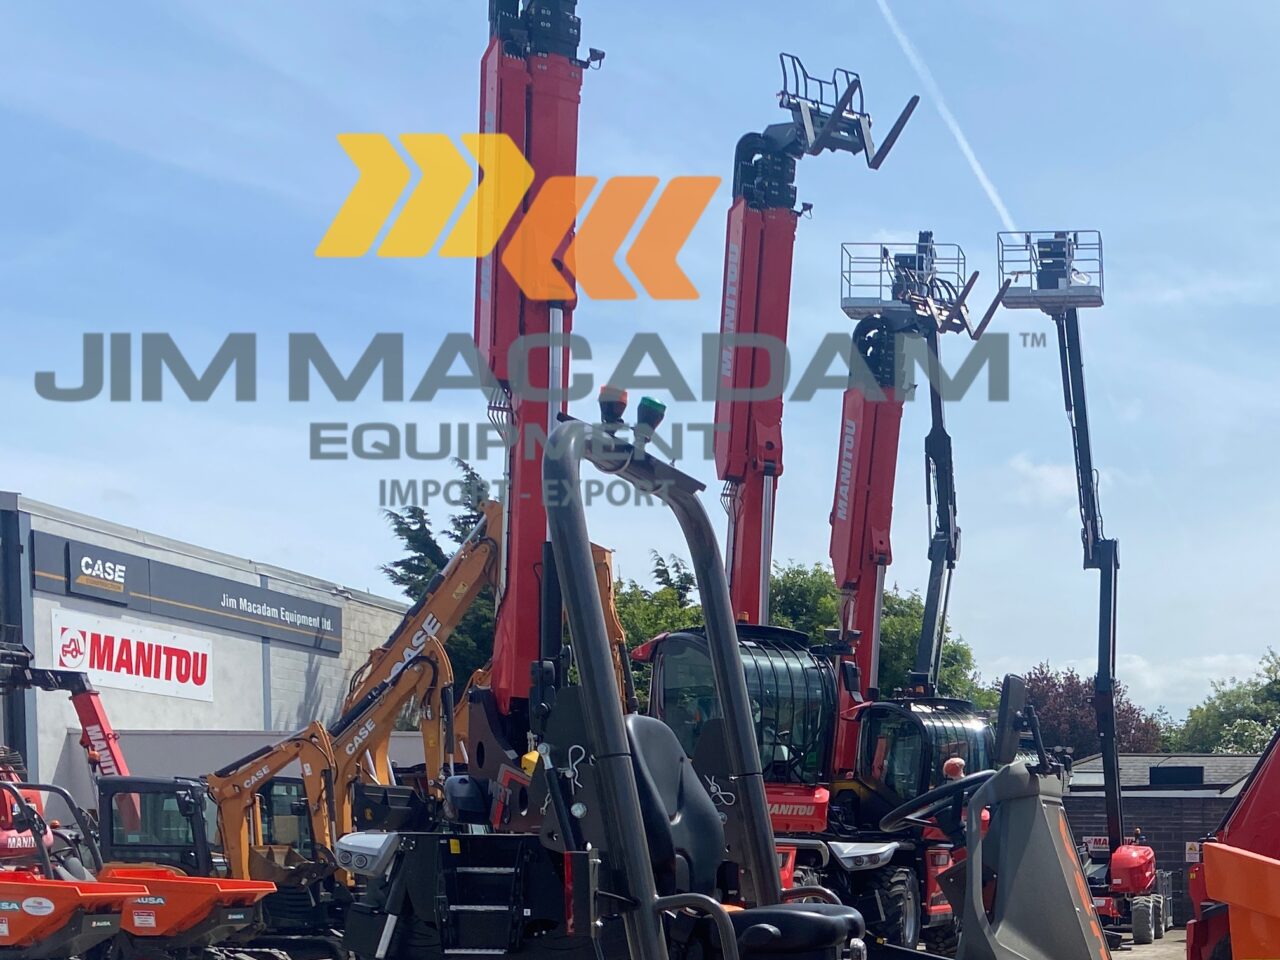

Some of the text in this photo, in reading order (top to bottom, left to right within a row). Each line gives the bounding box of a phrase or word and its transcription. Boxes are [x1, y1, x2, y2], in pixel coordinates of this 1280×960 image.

[837, 419, 857, 521] MANITOU
[80, 556, 126, 583] CASE
[220, 593, 237, 610] Jim
[240, 597, 279, 619] Macadam
[280, 607, 320, 629] Equipment
[88, 633, 208, 687] MANITOU
[346, 718, 377, 755] CASE
[243, 765, 271, 789] CASE
[0, 902, 20, 911] SA
